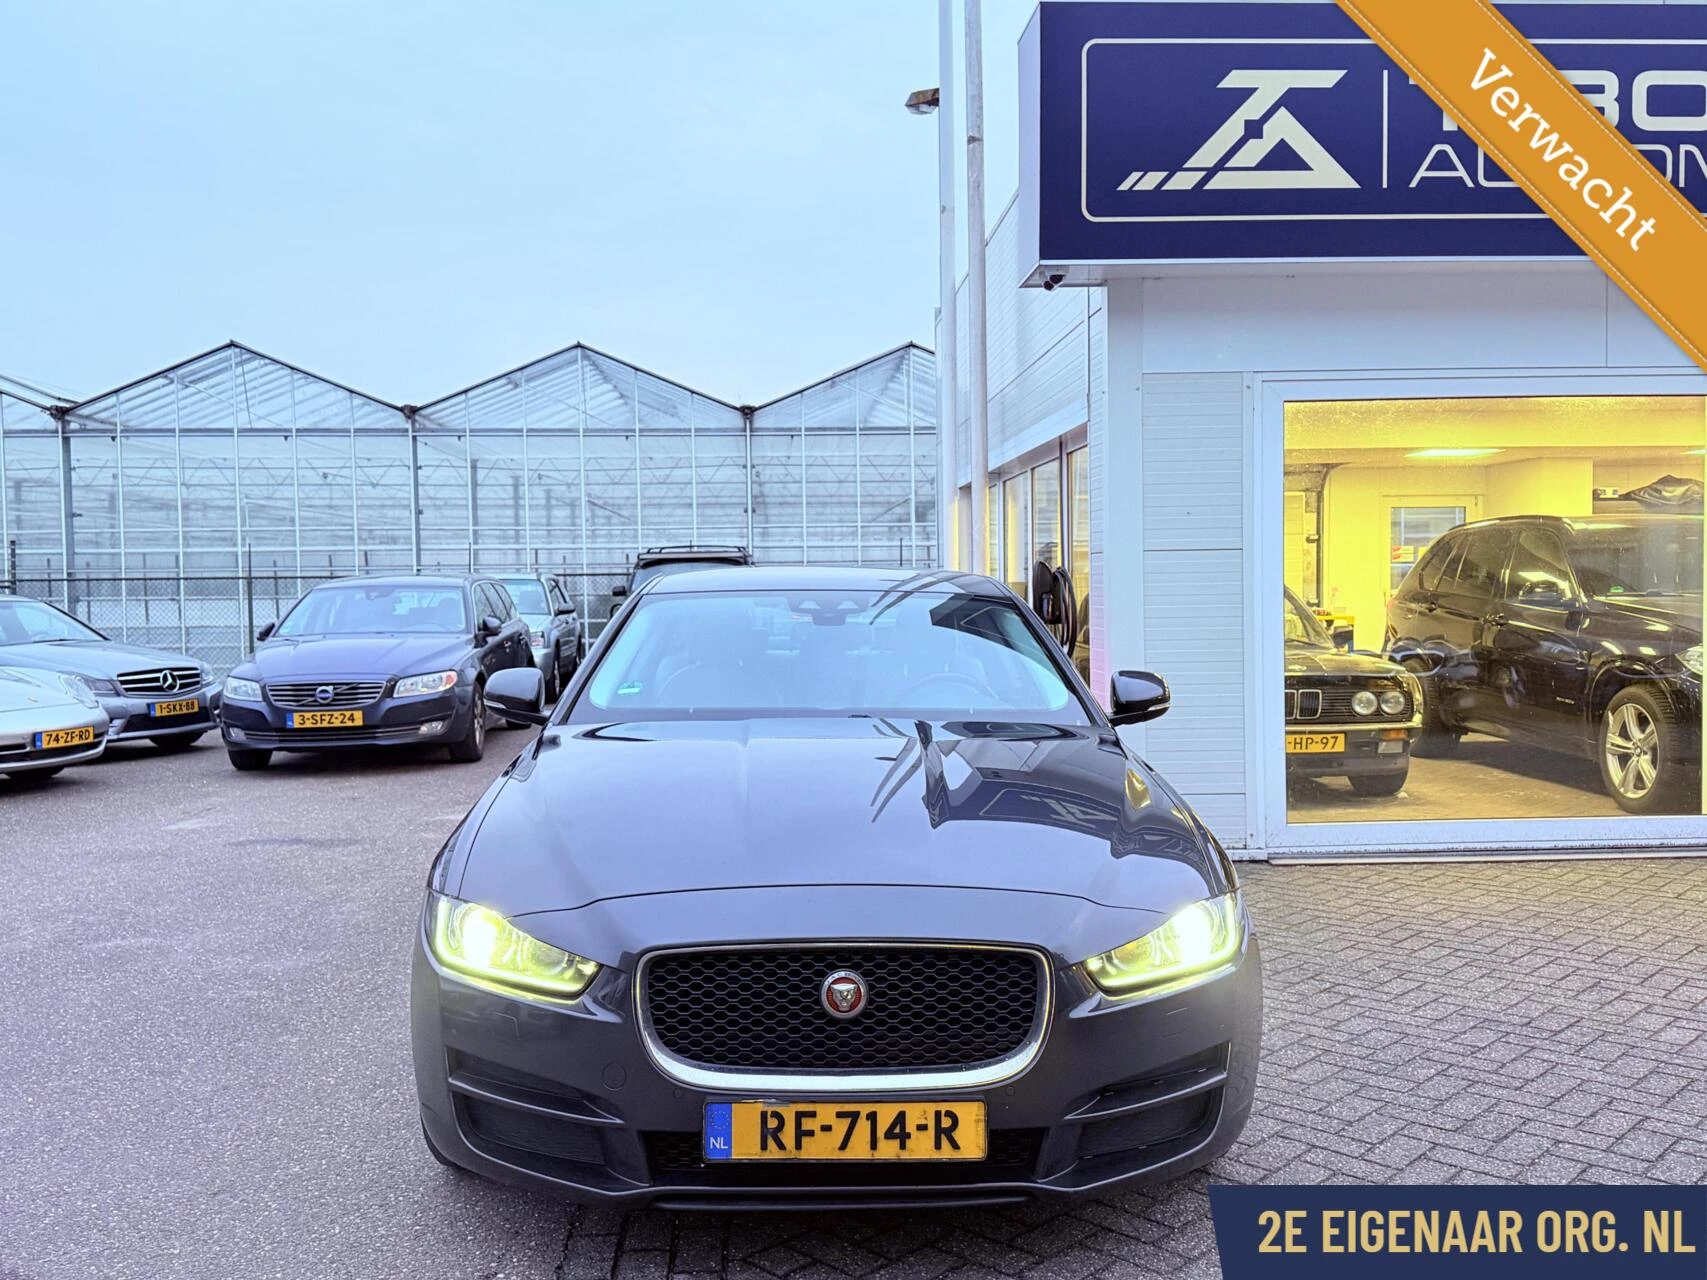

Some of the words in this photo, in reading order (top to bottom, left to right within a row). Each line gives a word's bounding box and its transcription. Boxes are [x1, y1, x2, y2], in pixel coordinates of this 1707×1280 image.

[298, 713, 355, 725] 3-SFZ-24
[46, 728, 91, 745] 74-ZF-RD
[759, 1109, 961, 1151] RF-714-R
[709, 1136, 728, 1149] NL
